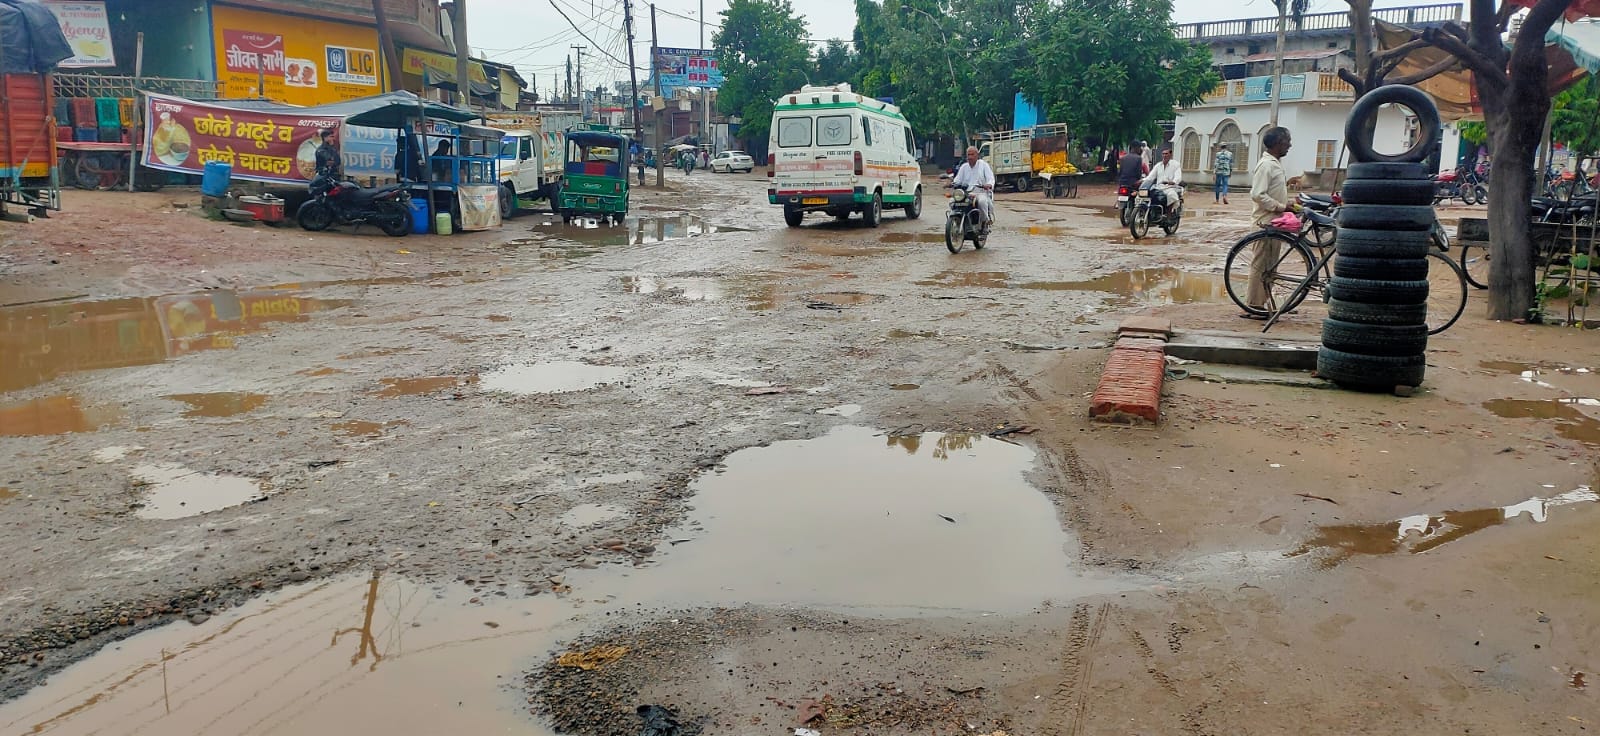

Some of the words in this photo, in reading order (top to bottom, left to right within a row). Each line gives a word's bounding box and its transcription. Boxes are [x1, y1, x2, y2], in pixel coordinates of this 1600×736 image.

[226, 44, 259, 69] जीवन
[349, 51, 372, 73] LIC
[193, 113, 234, 138] छोले
[236, 119, 276, 149] भटूरे
[278, 126, 295, 143] व
[239, 152, 293, 174] चावल
